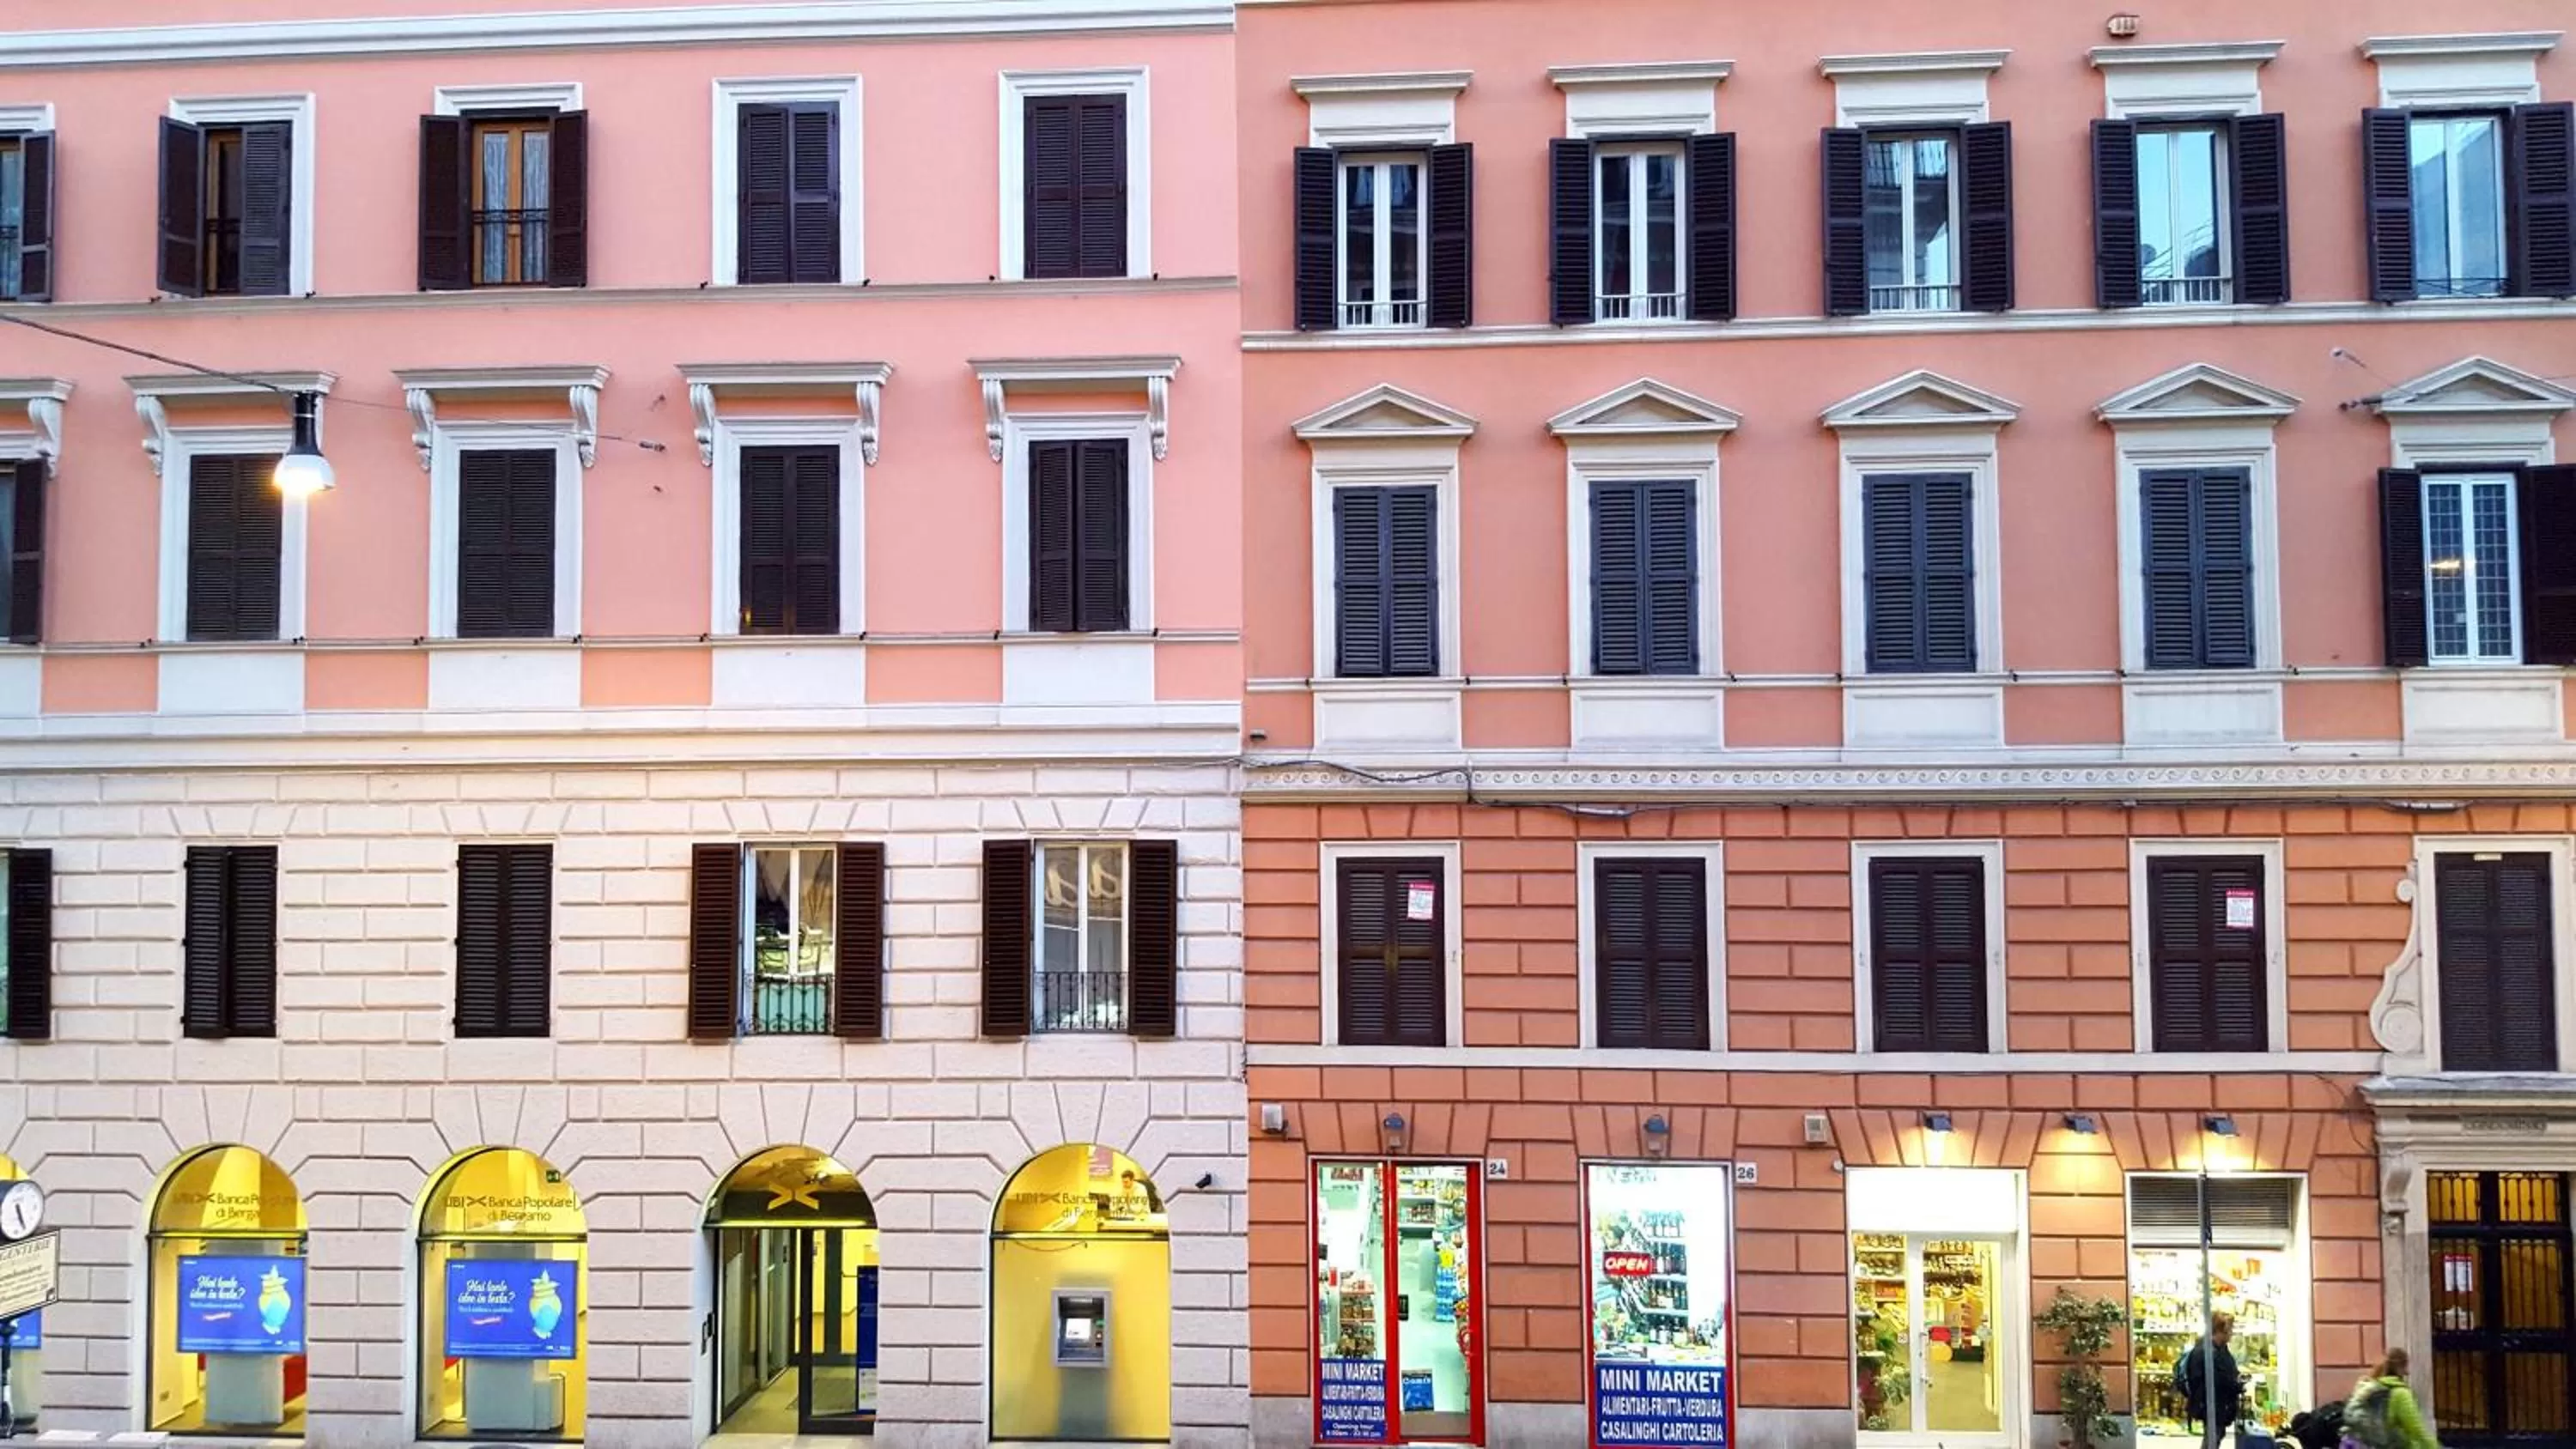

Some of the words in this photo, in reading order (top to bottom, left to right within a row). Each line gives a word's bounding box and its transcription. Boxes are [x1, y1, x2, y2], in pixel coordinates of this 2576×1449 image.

[1489, 1163, 1506, 1175] 24
[1736, 1167, 1755, 1179] 26
[216, 1192, 249, 1204] Banca
[446, 1196, 465, 1208] UBI
[489, 1196, 523, 1208] Banca
[523, 1196, 573, 1210] Popolare
[228, 1207, 261, 1222] Berga
[487, 1210, 497, 1222] di
[500, 1210, 552, 1222] Bergamo
[1605, 1257, 1649, 1270] OPEN
[1321, 1362, 1343, 1380] MINI
[1346, 1362, 1385, 1381] MARKET
[1601, 1369, 1640, 1391] MINI
[1646, 1370, 1722, 1392] MARKET
[1600, 1420, 1660, 1440] CASALINGHI
[1662, 1422, 1724, 1441] CARTOLERIA
